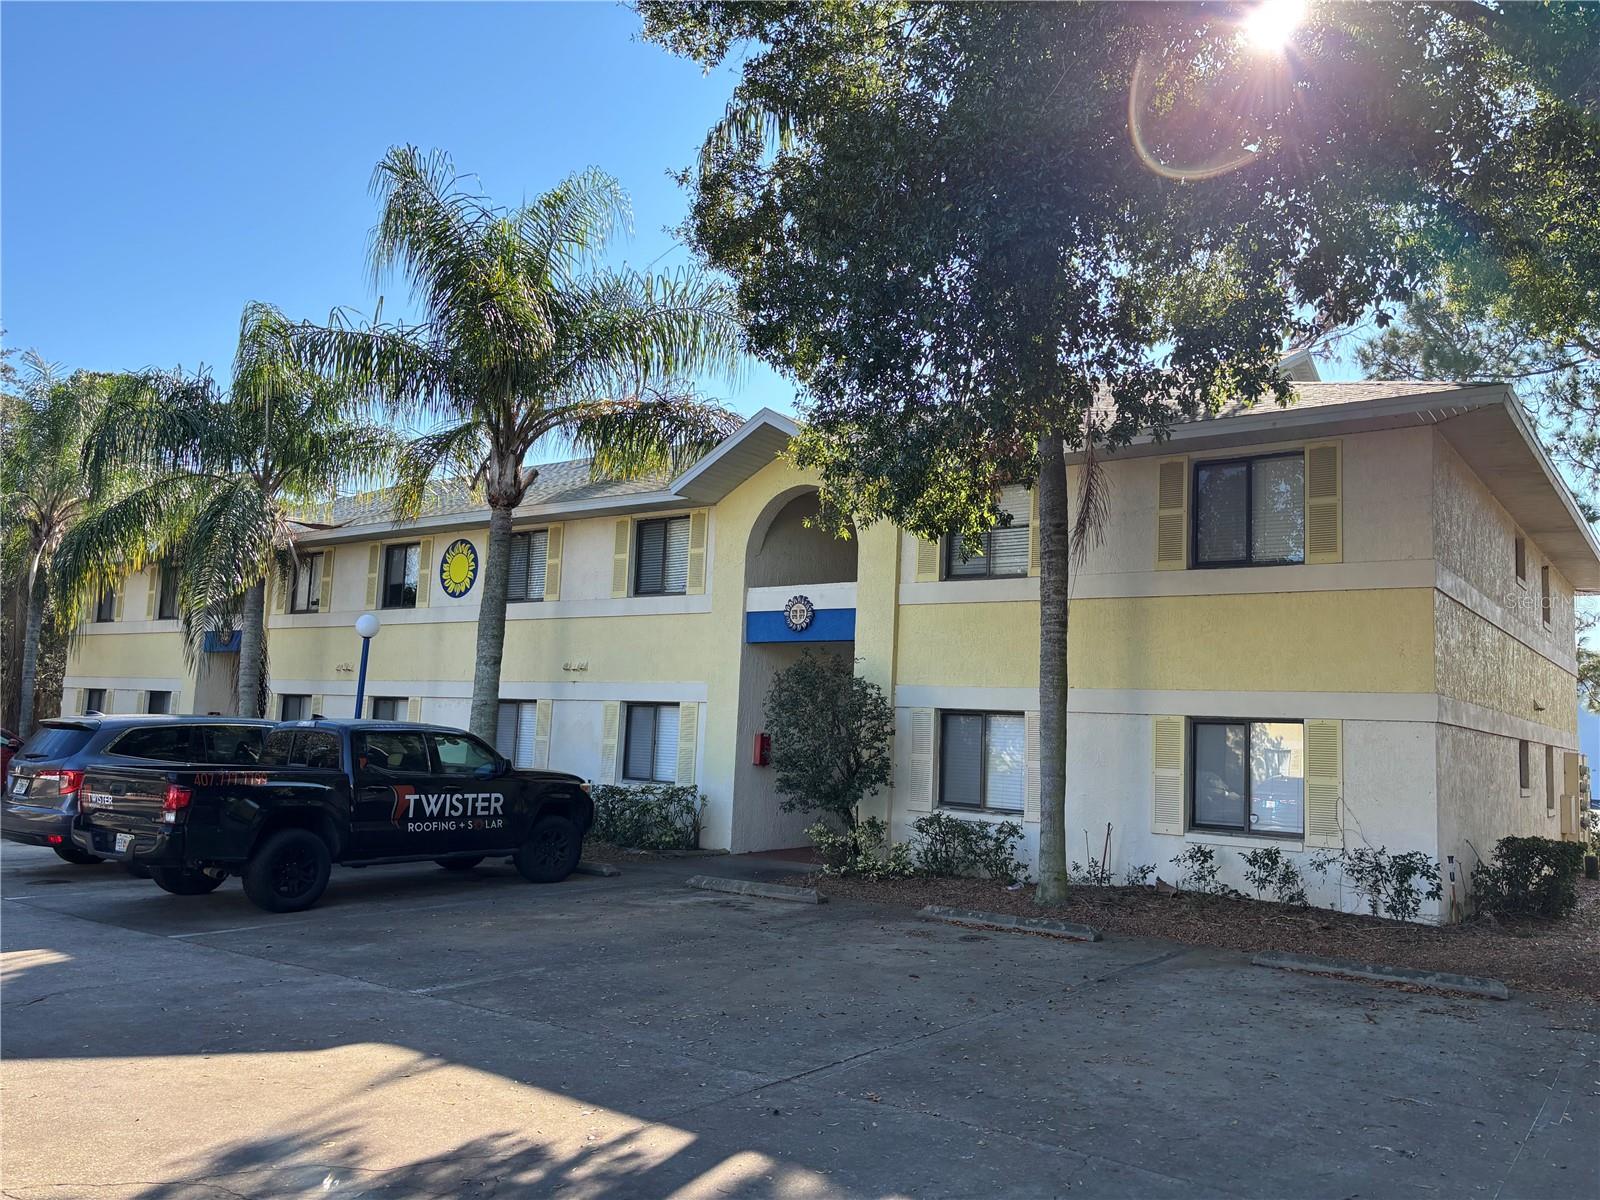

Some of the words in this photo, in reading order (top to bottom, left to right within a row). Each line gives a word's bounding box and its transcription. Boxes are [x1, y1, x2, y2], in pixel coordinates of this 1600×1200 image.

[88, 793, 113, 804] TWISTER
[405, 793, 504, 818] TWISTER
[408, 821, 456, 832] ROOFING
